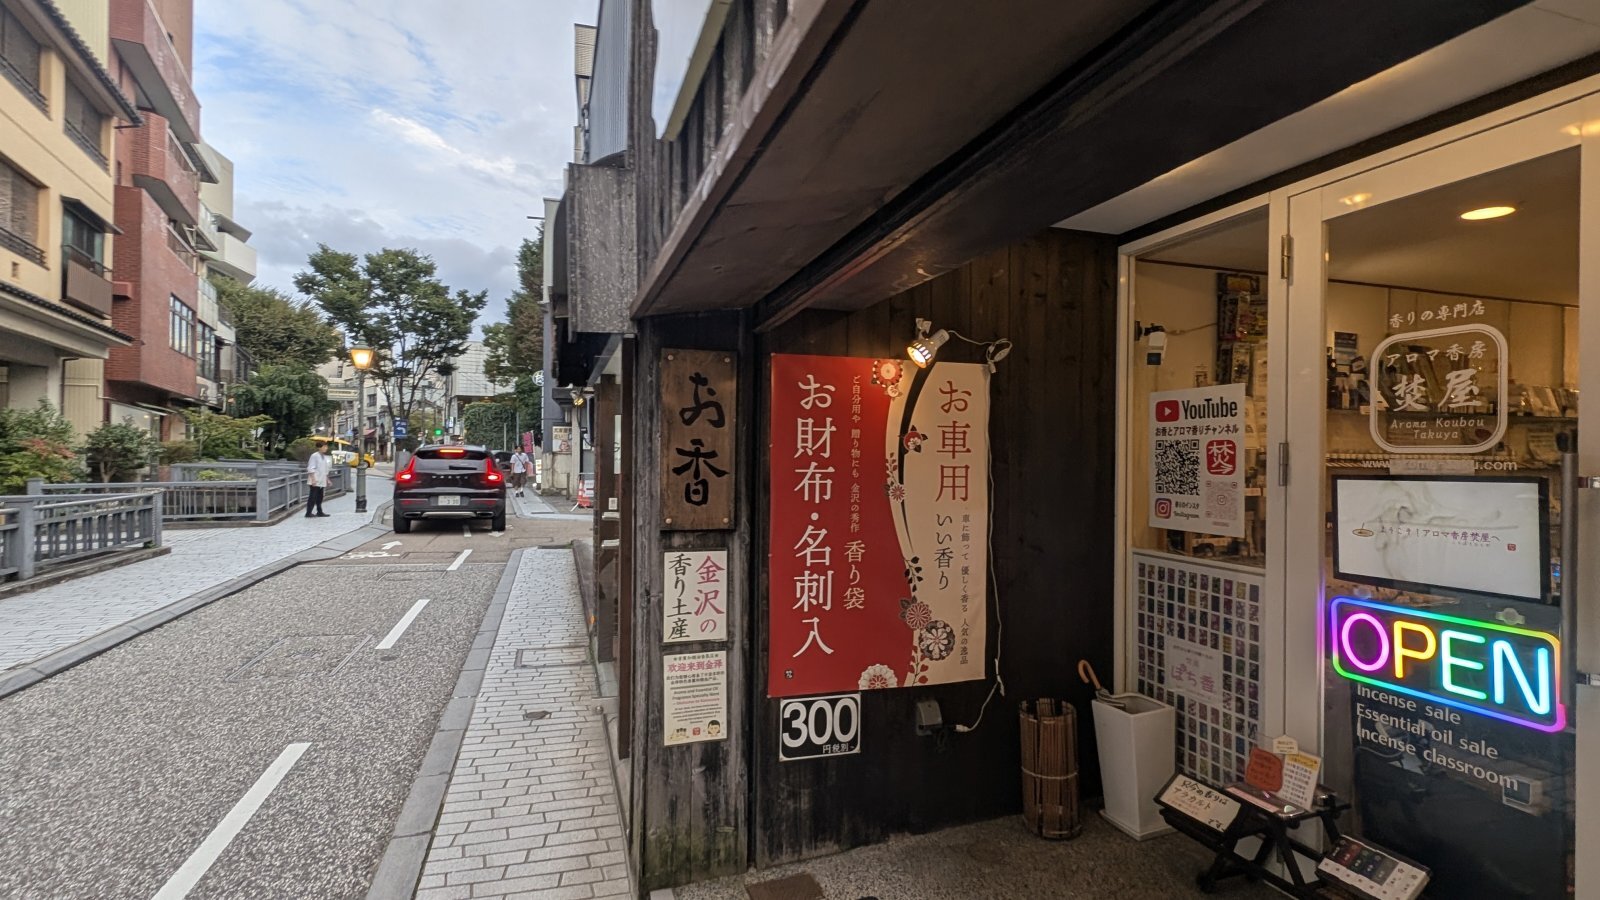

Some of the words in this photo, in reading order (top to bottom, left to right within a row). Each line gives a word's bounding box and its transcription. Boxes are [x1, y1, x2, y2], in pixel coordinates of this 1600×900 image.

[1389, 300, 1485, 328] 香りの専門店
[1387, 341, 1487, 367] アロマ香房
[851, 375, 861, 424] ご自分用や
[1181, 396, 1238, 420] YouTube
[1392, 368, 1482, 412] 焚屋
[672, 372, 730, 506] お香
[935, 380, 972, 502] お車用
[1155, 424, 1239, 436] お香とアロマ香りチャンネル
[1390, 419, 1427, 429] Aroma
[1436, 418, 1485, 428] Koubou
[1413, 430, 1459, 441] Takuya
[851, 428, 861, 478] 贈り物にも
[793, 374, 837, 658] お財布・名刺入
[850, 483, 861, 533] 金沢の秀作
[843, 540, 866, 610] 香り袋
[934, 513, 954, 591] いい香り
[666, 553, 692, 640] 香り土産
[694, 555, 725, 633] 金沢の
[1341, 612, 1550, 715] OPEN
[782, 698, 858, 748] 300
[1357, 684, 1417, 711] Incense
[1425, 705, 1461, 725] sale
[1356, 702, 1425, 737] Essential
[1431, 729, 1453, 745] oil
[1459, 738, 1498, 759] sale
[1356, 722, 1416, 756] Incense
[1423, 748, 1518, 791] classroom
